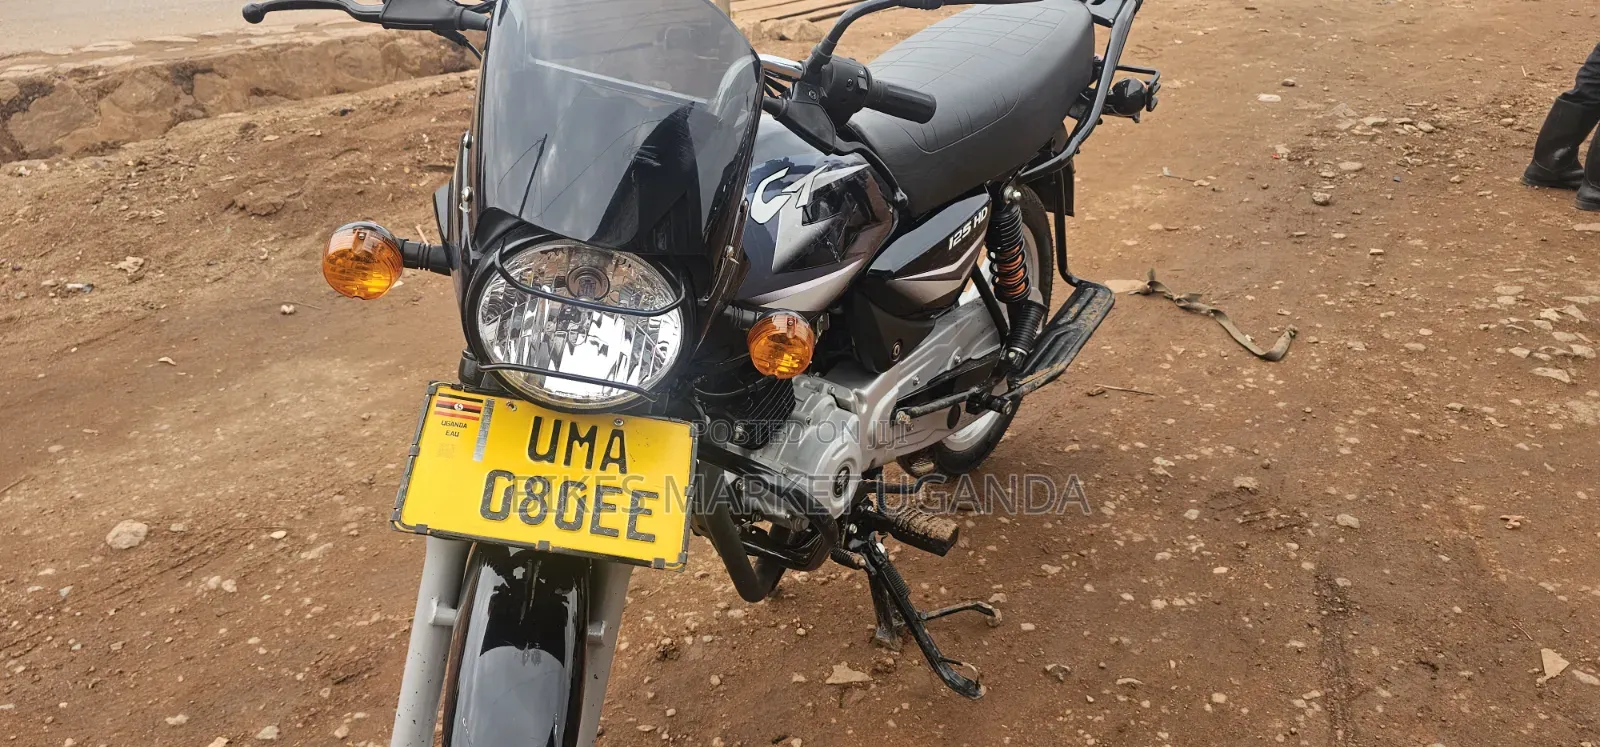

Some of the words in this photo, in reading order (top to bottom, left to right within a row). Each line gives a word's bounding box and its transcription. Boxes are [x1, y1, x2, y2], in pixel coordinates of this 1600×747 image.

[750, 164, 831, 224] CT
[948, 220, 972, 251] 125
[973, 206, 988, 229] HD
[441, 420, 468, 429] UGANDA
[445, 430, 460, 438] EAU
[527, 416, 627, 474] UMA
